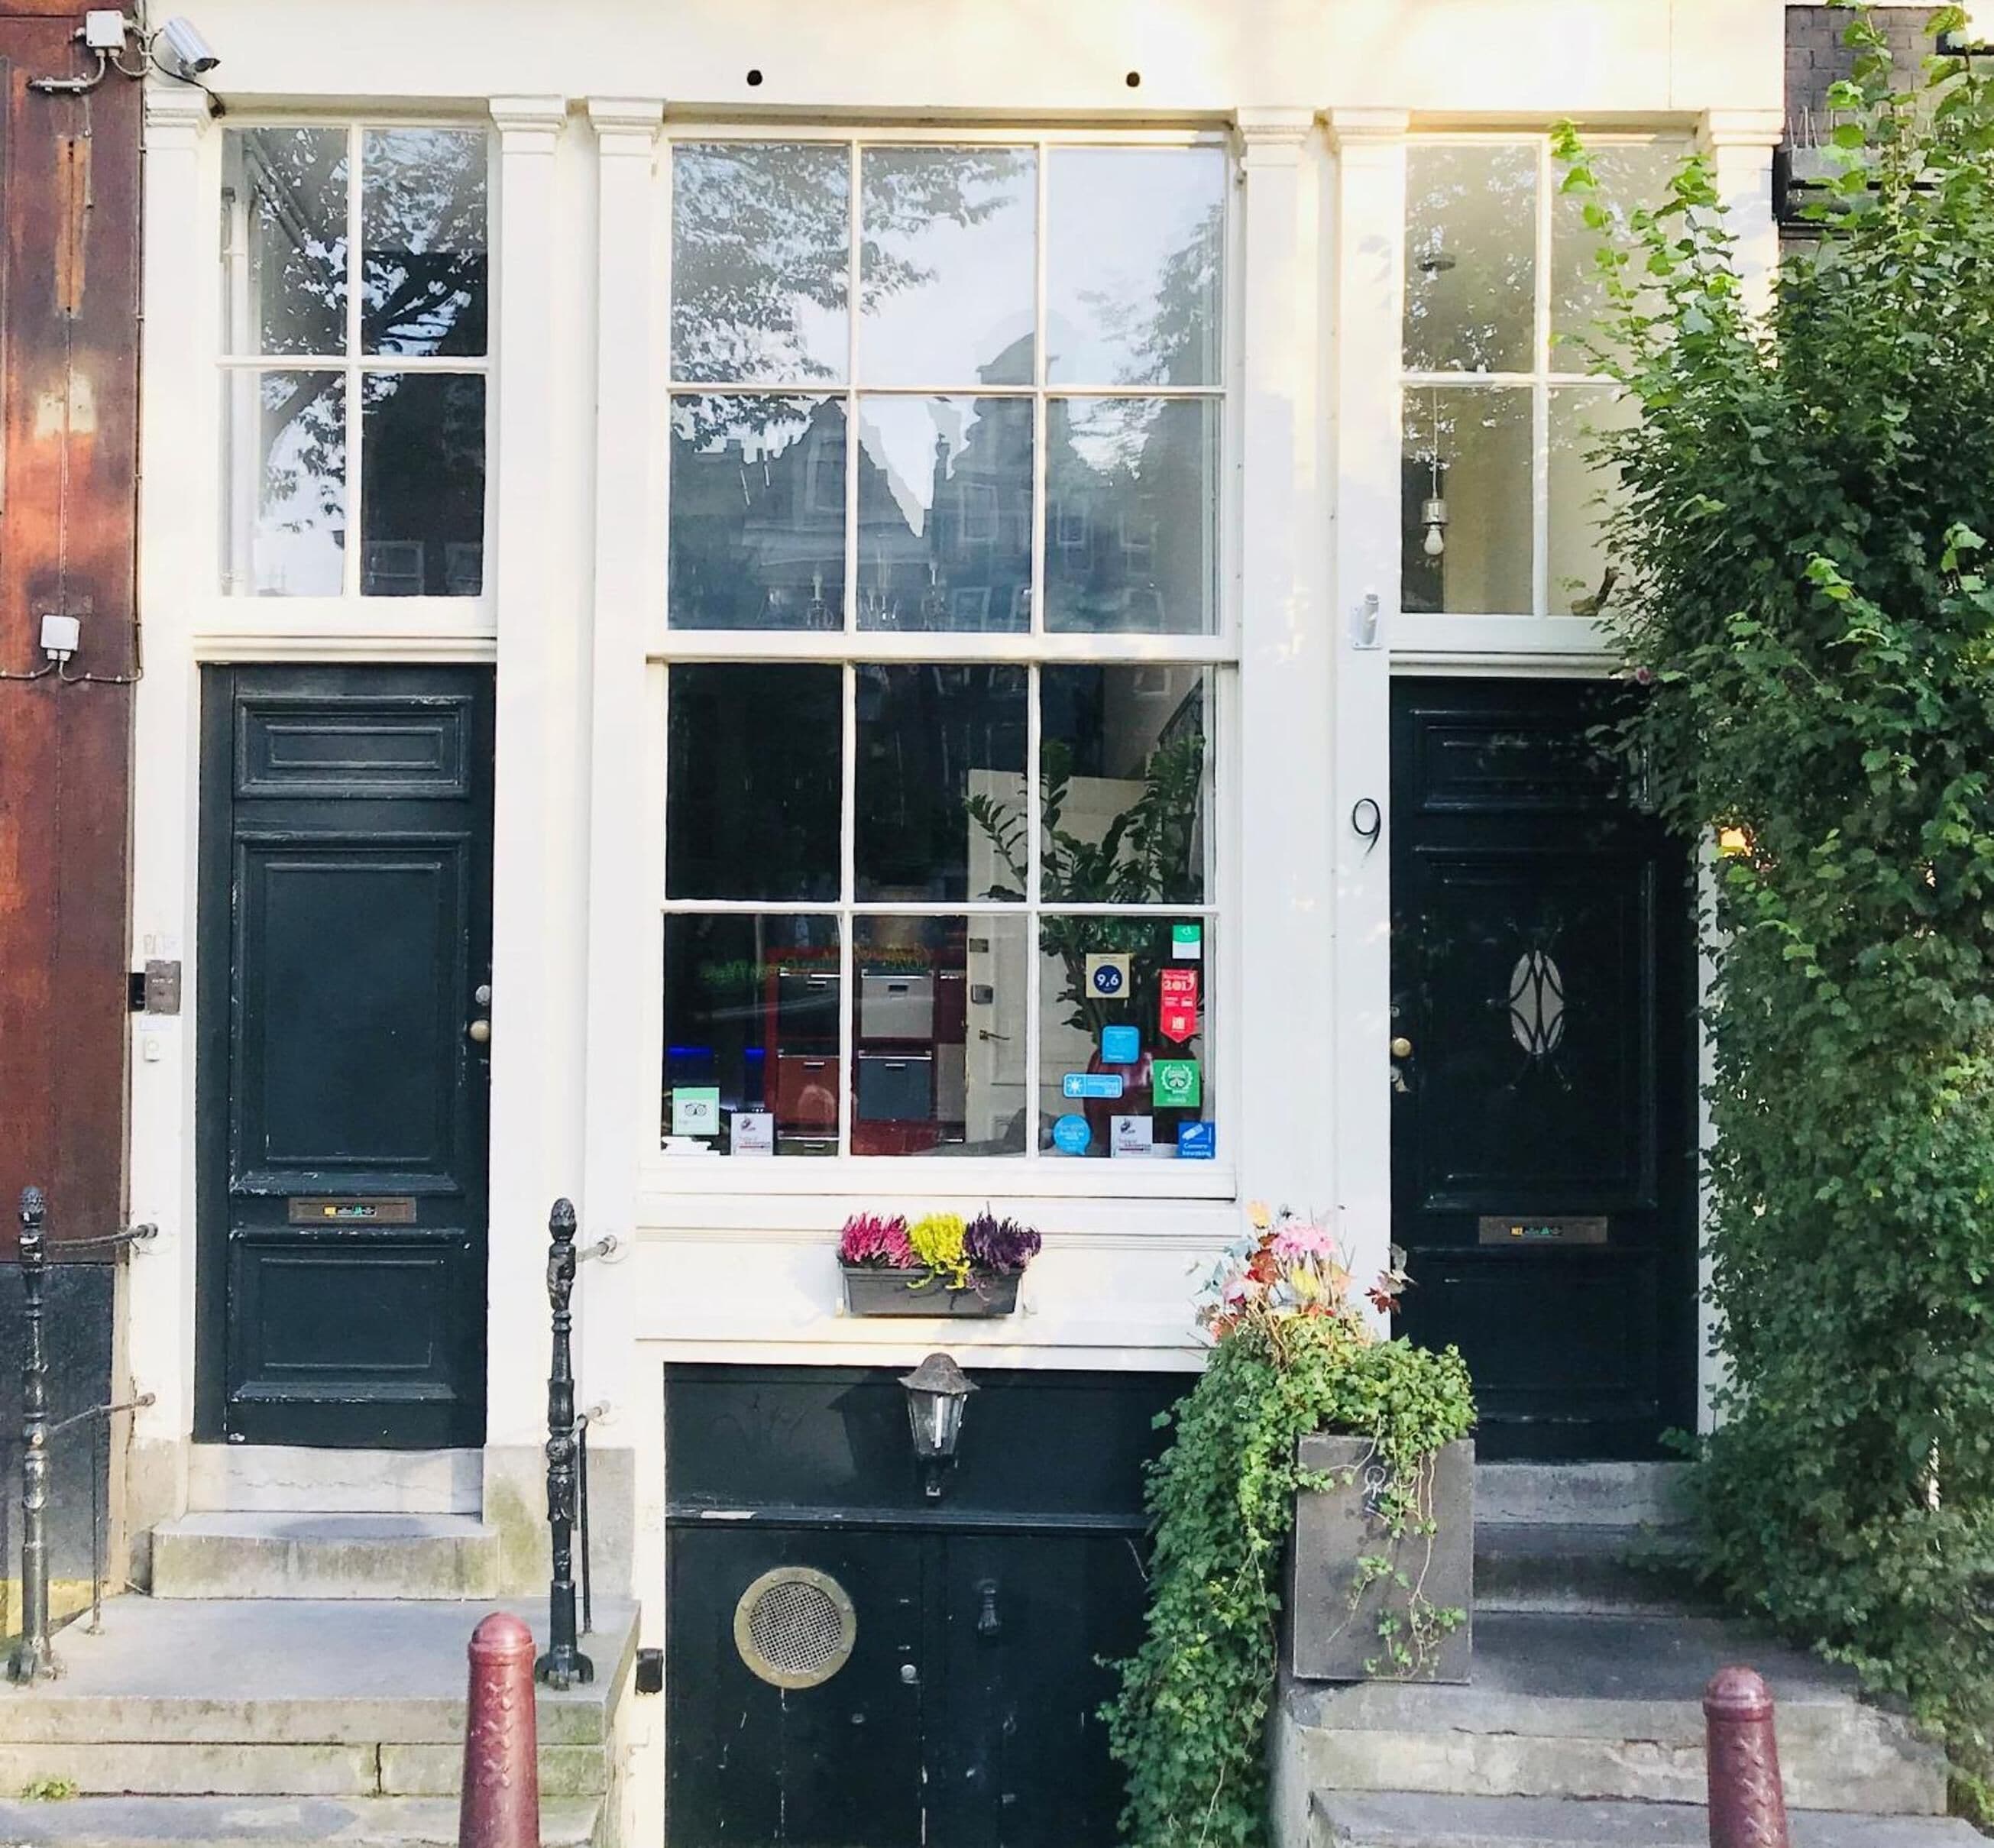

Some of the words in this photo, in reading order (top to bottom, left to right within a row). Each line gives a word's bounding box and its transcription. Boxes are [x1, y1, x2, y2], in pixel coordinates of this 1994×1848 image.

[1351, 798, 1381, 858] 9
[1097, 973, 1119, 987] 9,6
[1164, 974, 1196, 992] 2017
